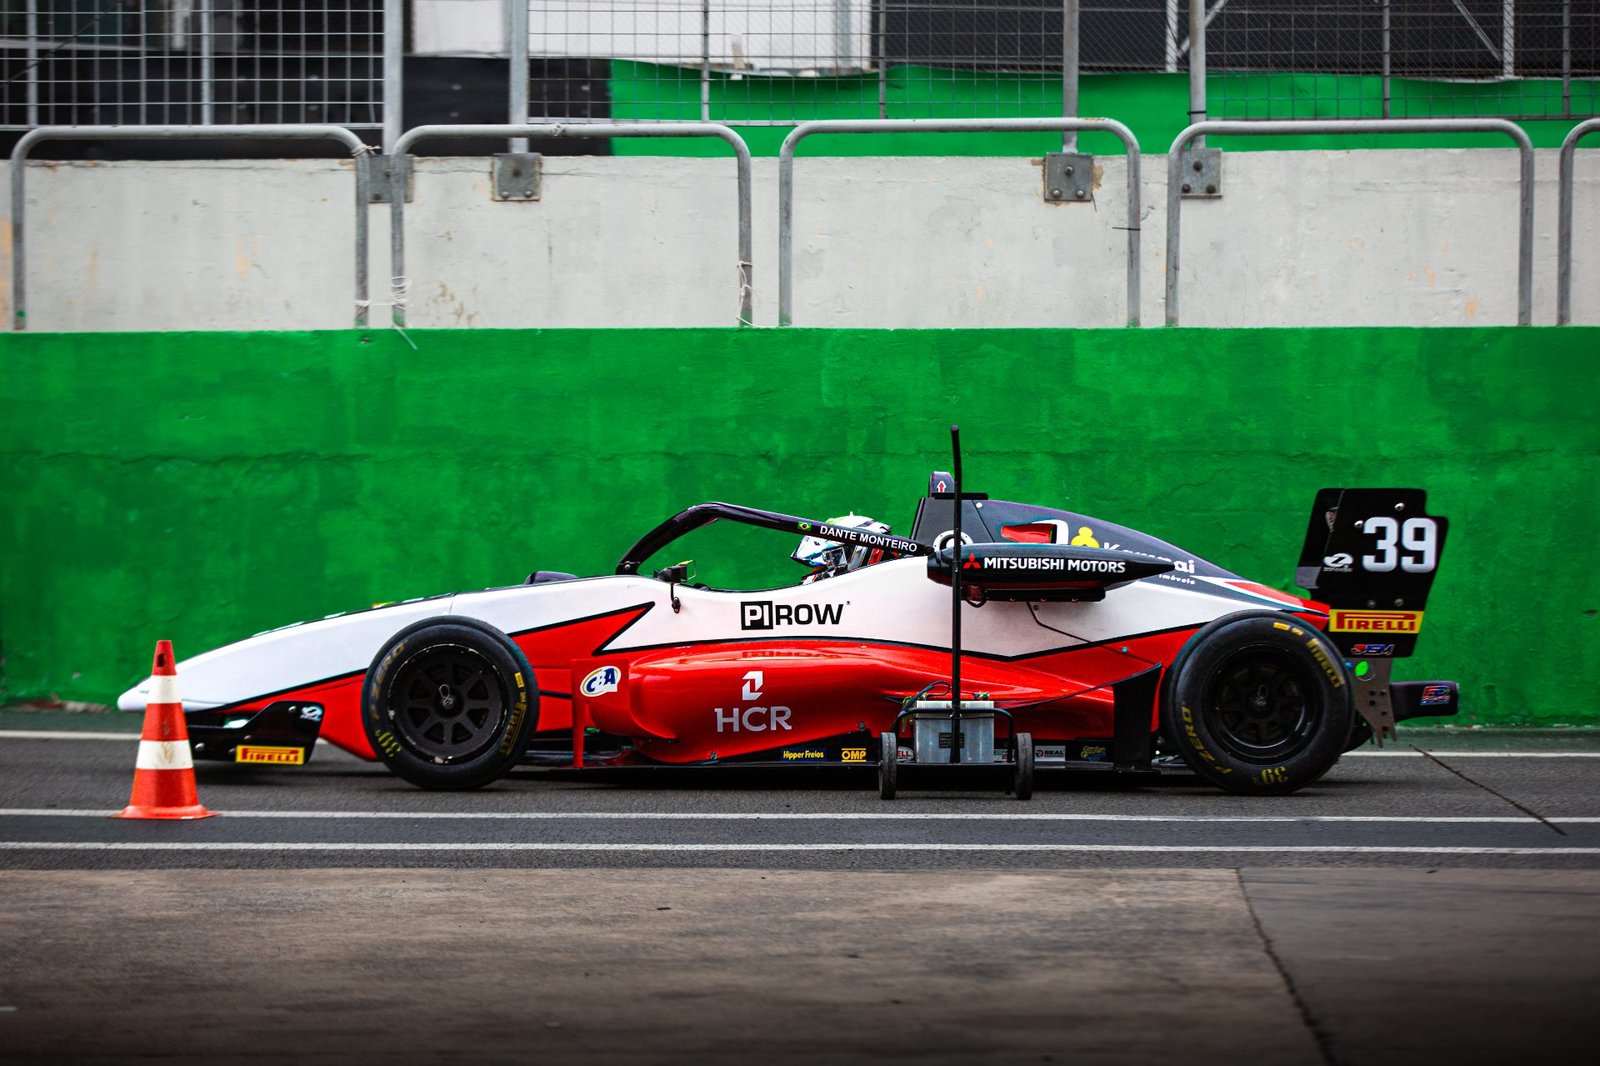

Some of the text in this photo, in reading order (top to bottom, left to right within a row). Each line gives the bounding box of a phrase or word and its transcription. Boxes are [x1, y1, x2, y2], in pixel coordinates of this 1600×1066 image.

[820, 525, 918, 553] DANTE MONTEIRO
[1362, 516, 1437, 573] 39
[984, 557, 1126, 573] MITSUBISHI MOTORS
[740, 601, 844, 630] PIROW
[1336, 611, 1416, 632] PIRELLI
[1306, 638, 1346, 689] PIRELLI
[586, 667, 616, 693] CBA
[714, 705, 793, 733] HCR
[1181, 705, 1233, 775] P ZERO
[241, 747, 299, 762] PIRELLI
[783, 749, 804, 761] Hipper
[841, 750, 867, 760] OMP
